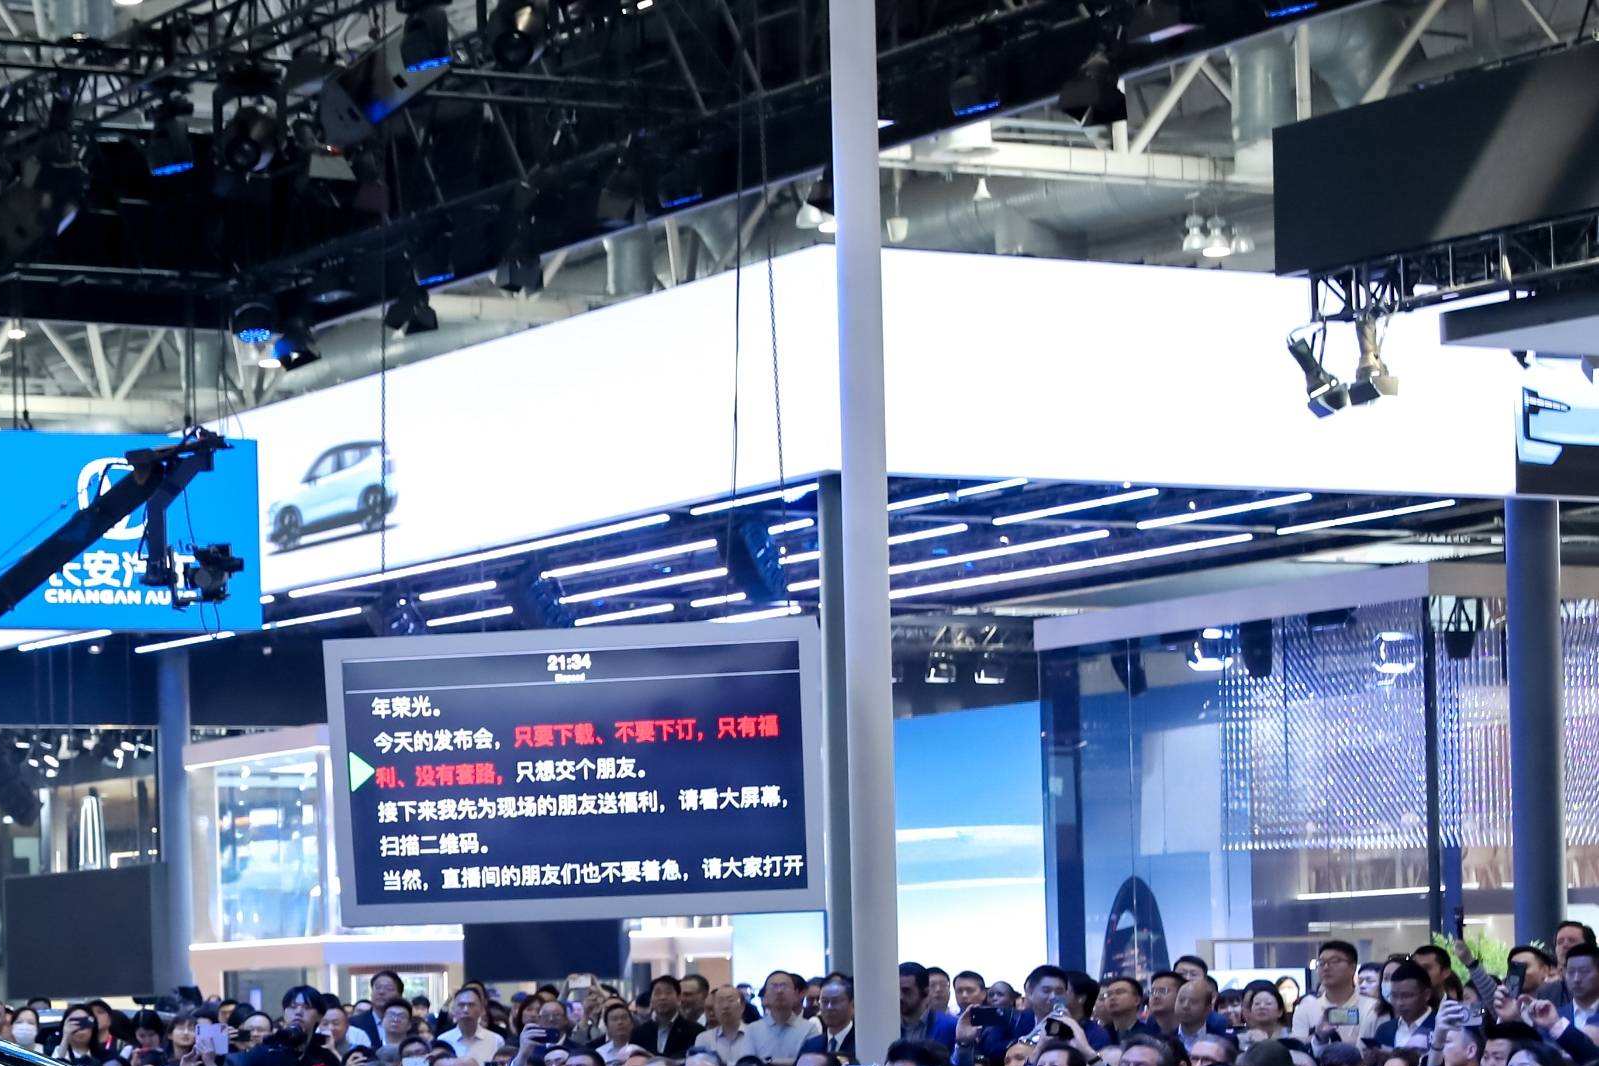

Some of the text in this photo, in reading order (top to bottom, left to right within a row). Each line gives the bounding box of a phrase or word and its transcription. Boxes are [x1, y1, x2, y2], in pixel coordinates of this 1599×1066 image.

[44, 588, 142, 604] CHANGAN
[546, 653, 592, 671] 21:34
[371, 695, 441, 719] 年荣光。
[379, 832, 489, 857] 扫描二维码。
